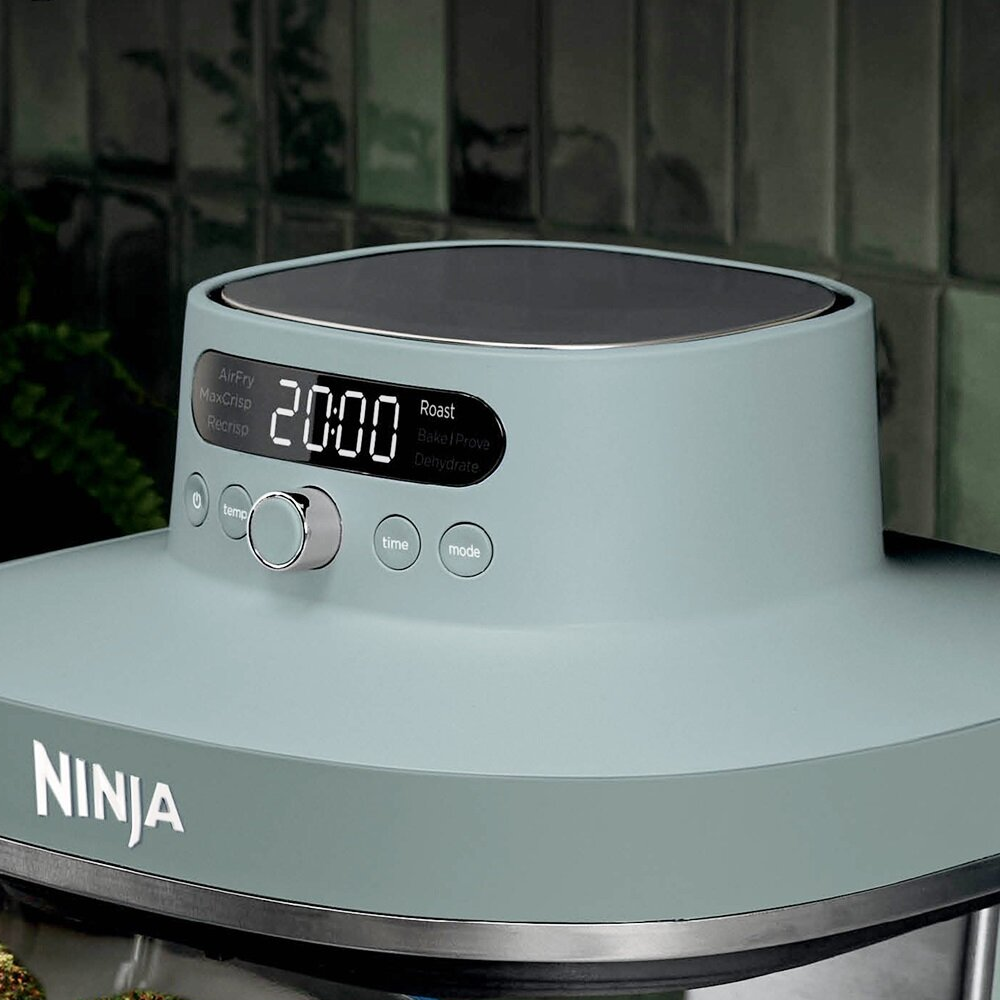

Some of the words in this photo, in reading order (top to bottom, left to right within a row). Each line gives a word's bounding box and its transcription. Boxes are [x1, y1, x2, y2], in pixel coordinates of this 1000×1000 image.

[218, 367, 254, 389] AirFry
[200, 387, 252, 410] MaxCrisp
[420, 399, 456, 420] Roast
[207, 415, 249, 437] Recrisp
[270, 378, 400, 464] 20:00
[414, 452, 479, 473] Dehydrate
[223, 503, 248, 521] temp
[382, 536, 409, 550] time
[449, 544, 481, 558] mode
[33, 739, 184, 848] NINJA
